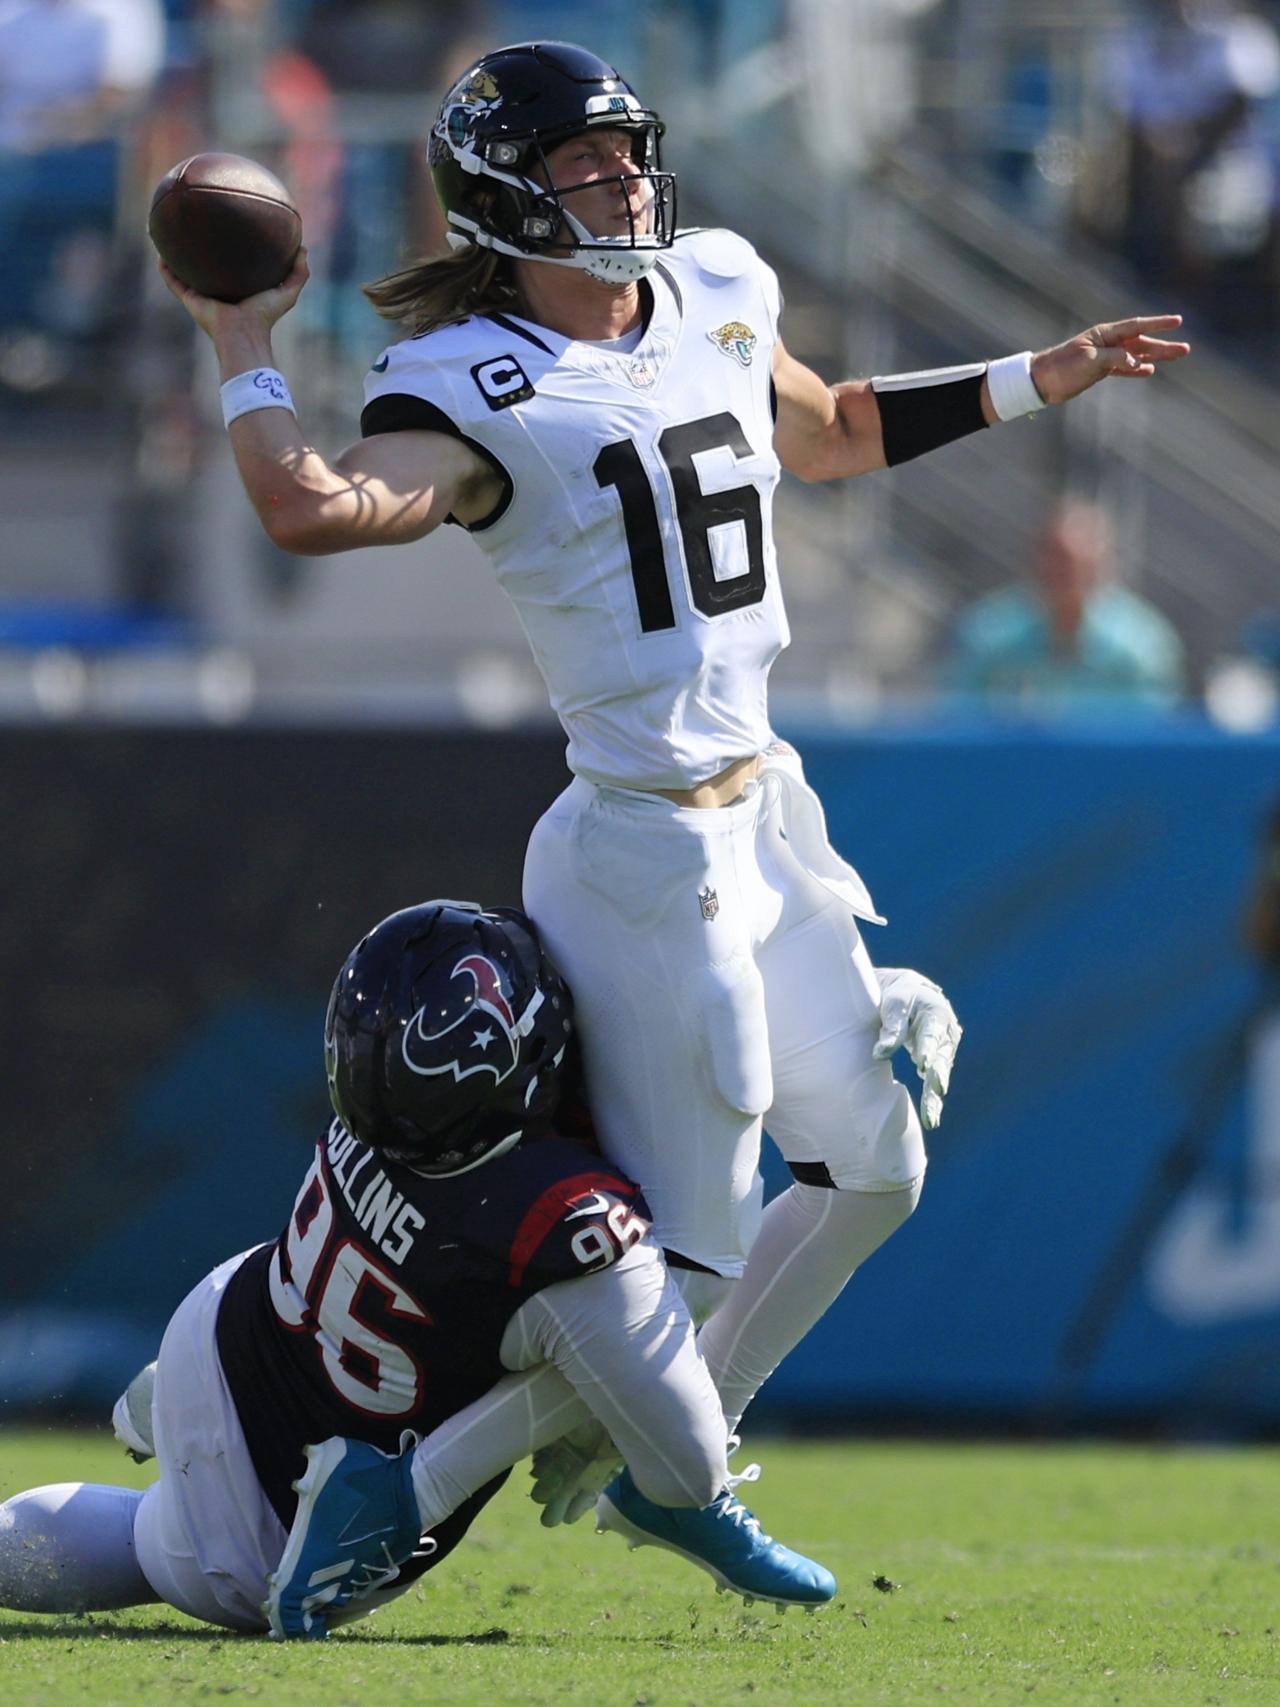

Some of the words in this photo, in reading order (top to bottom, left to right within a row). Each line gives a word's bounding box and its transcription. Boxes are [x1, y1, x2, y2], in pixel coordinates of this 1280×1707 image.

[478, 359, 524, 397] C
[591, 411, 768, 634] 16
[269, 1142, 426, 1415] 96
